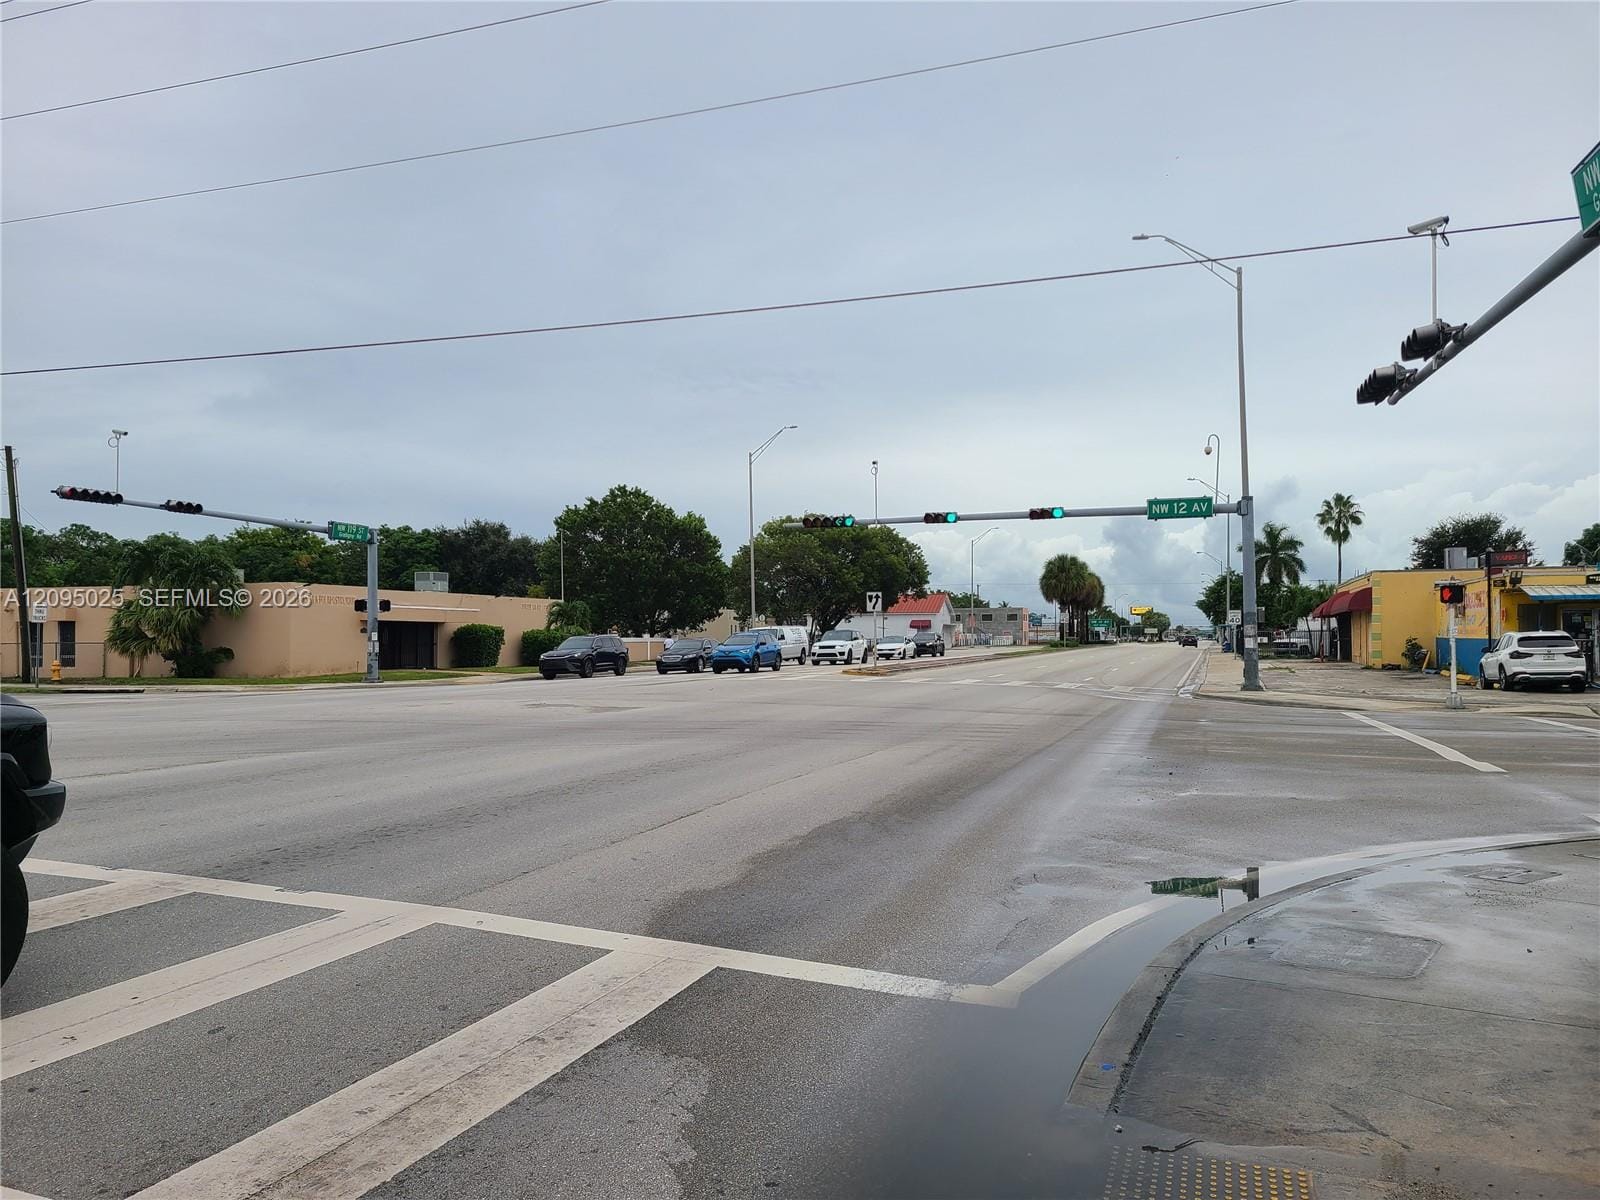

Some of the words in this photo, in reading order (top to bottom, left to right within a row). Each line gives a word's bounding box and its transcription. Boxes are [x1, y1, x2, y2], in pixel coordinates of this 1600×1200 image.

[1582, 157, 1600, 195] NW
[1152, 503, 1169, 514] NW
[1173, 502, 1187, 514] 12
[1192, 502, 1208, 512] AV
[347, 525, 357, 534] 119
